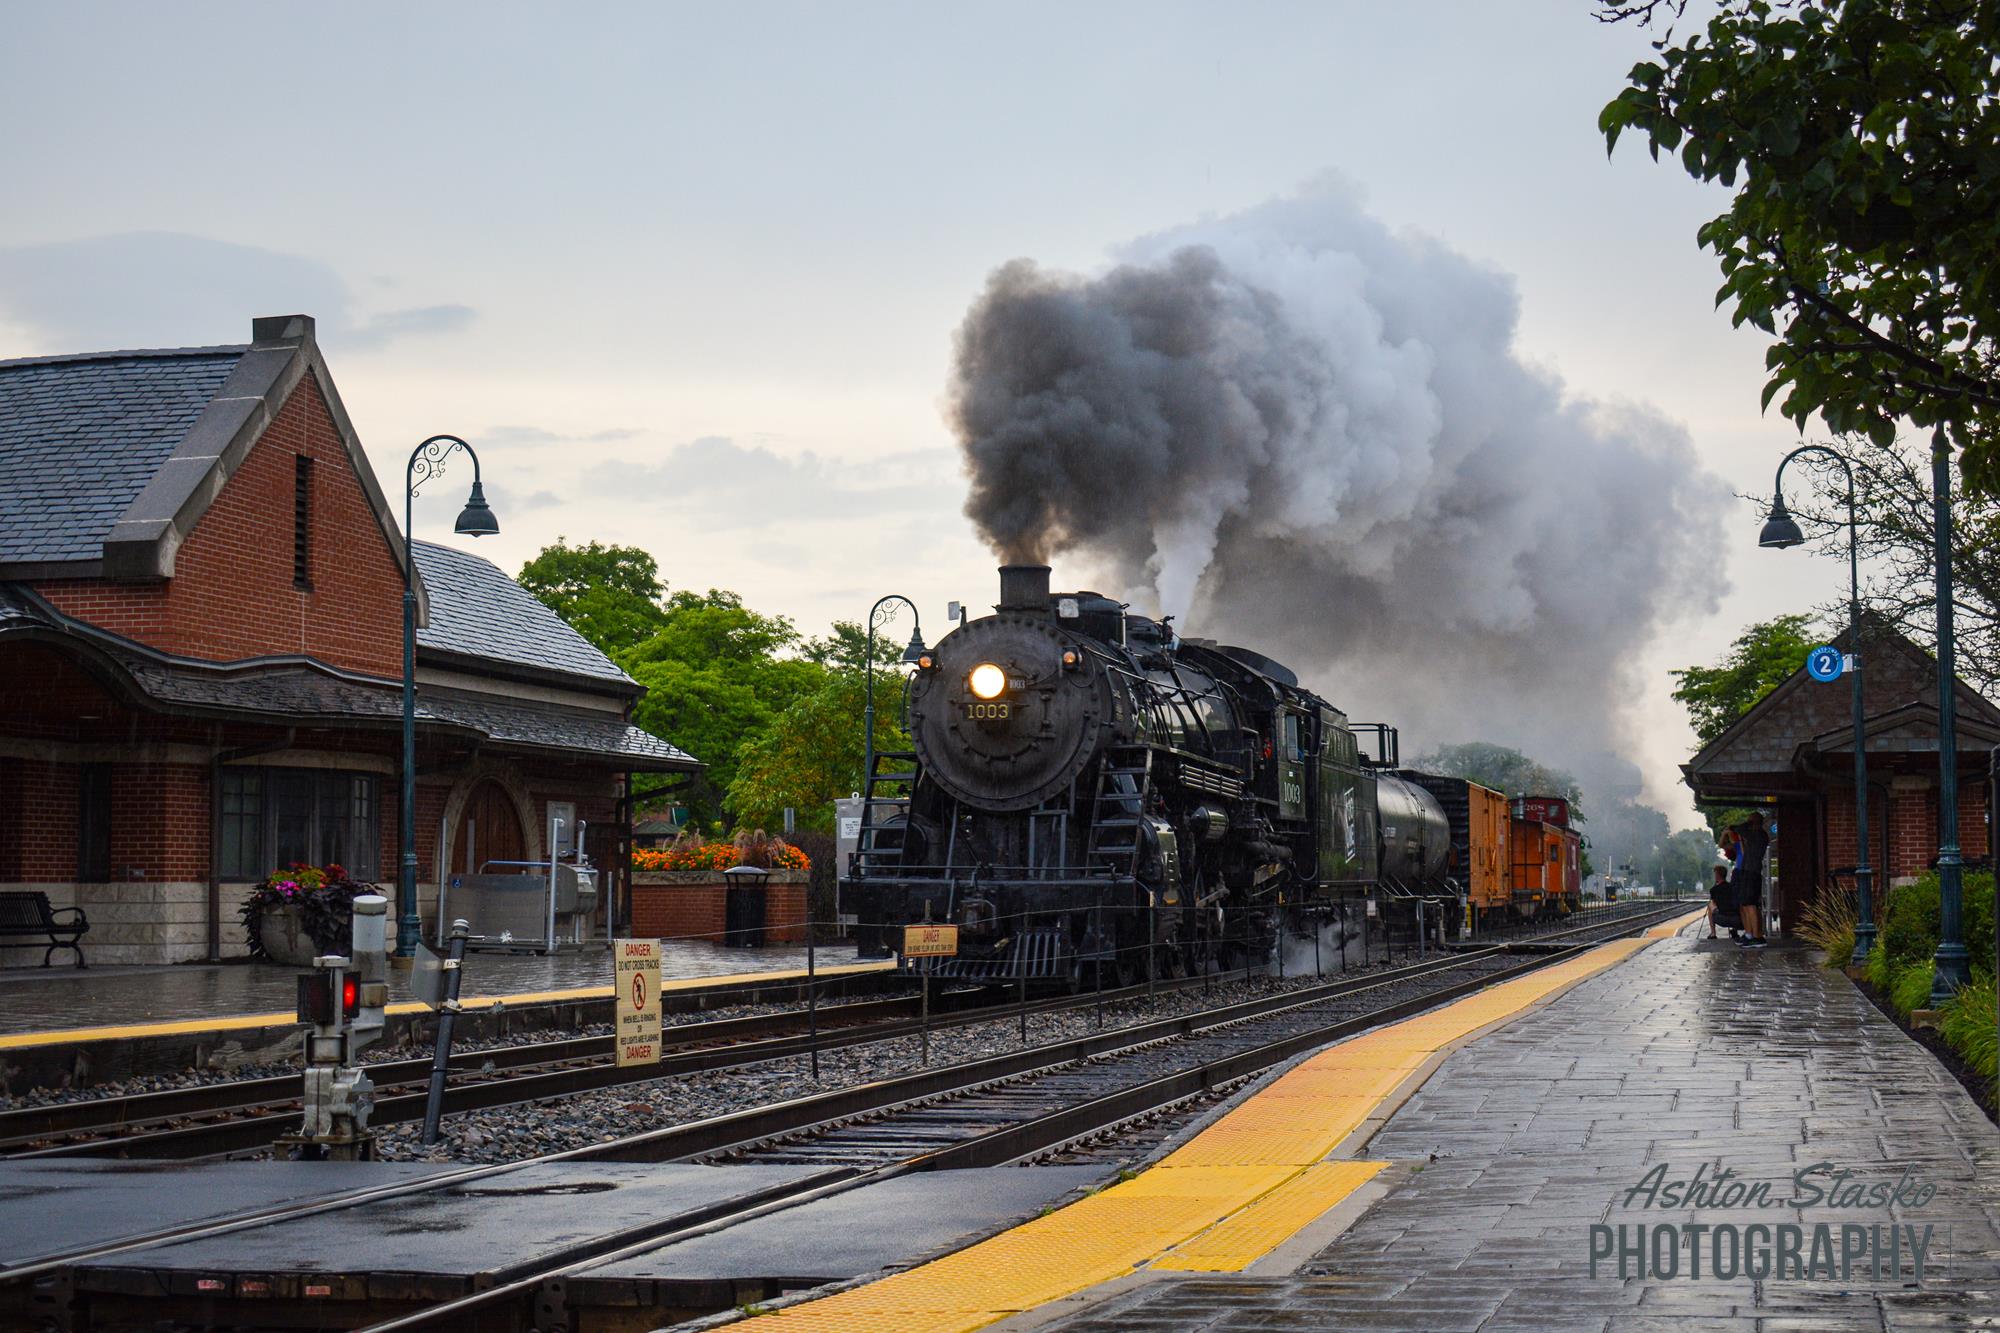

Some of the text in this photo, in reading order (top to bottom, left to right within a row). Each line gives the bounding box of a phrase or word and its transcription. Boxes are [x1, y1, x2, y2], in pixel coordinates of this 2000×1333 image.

[1820, 656, 1832, 672] 2
[968, 704, 1008, 718] 1003
[1284, 782, 1300, 804] 1003
[923, 930, 940, 942] DANGER
[626, 944, 650, 956] DANGER
[618, 960, 624, 971] DO
[632, 960, 644, 970] CROSS
[645, 959, 659, 969] TRACKS
[626, 1046, 651, 1059] DANGER
